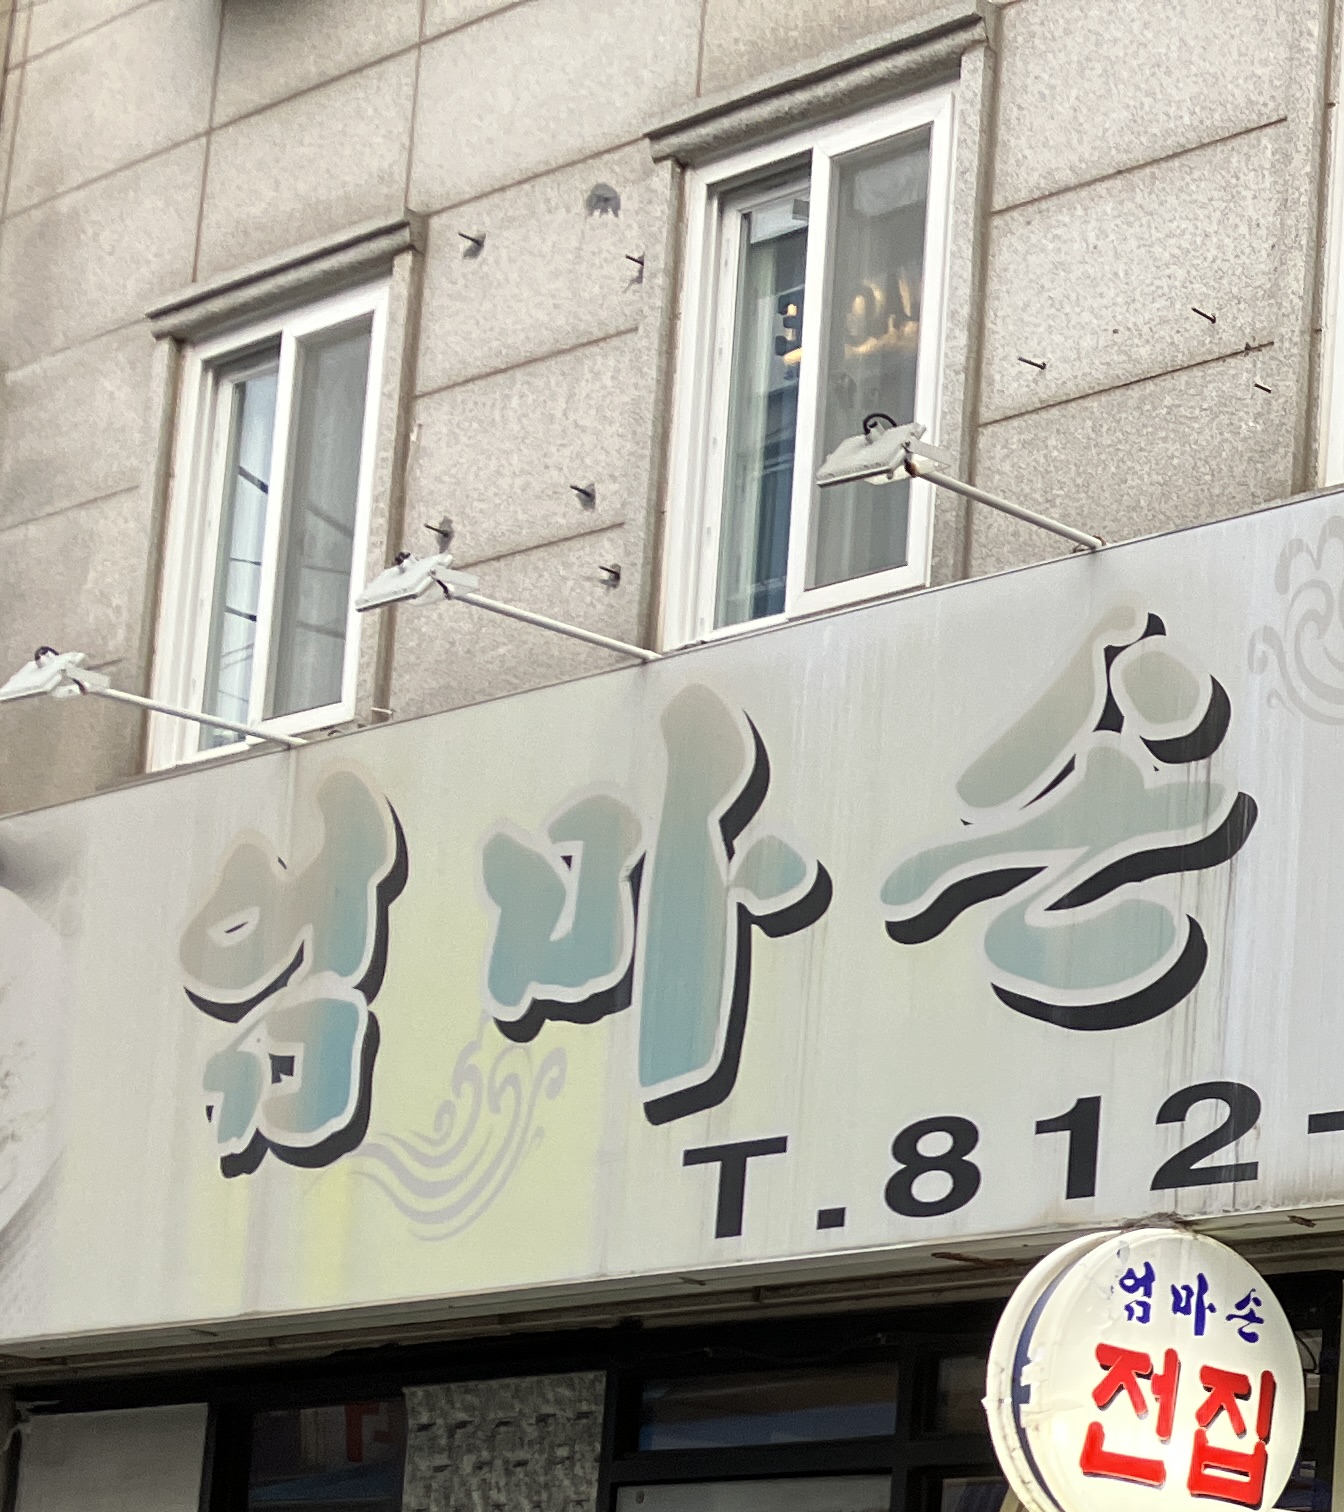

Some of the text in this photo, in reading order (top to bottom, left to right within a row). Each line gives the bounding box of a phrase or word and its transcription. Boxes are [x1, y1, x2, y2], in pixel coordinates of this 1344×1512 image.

[180, 607, 1258, 1177] 엄마손
[1119, 1261, 1264, 1343] 엄마손
[1080, 1342, 1277, 1510] 전집
